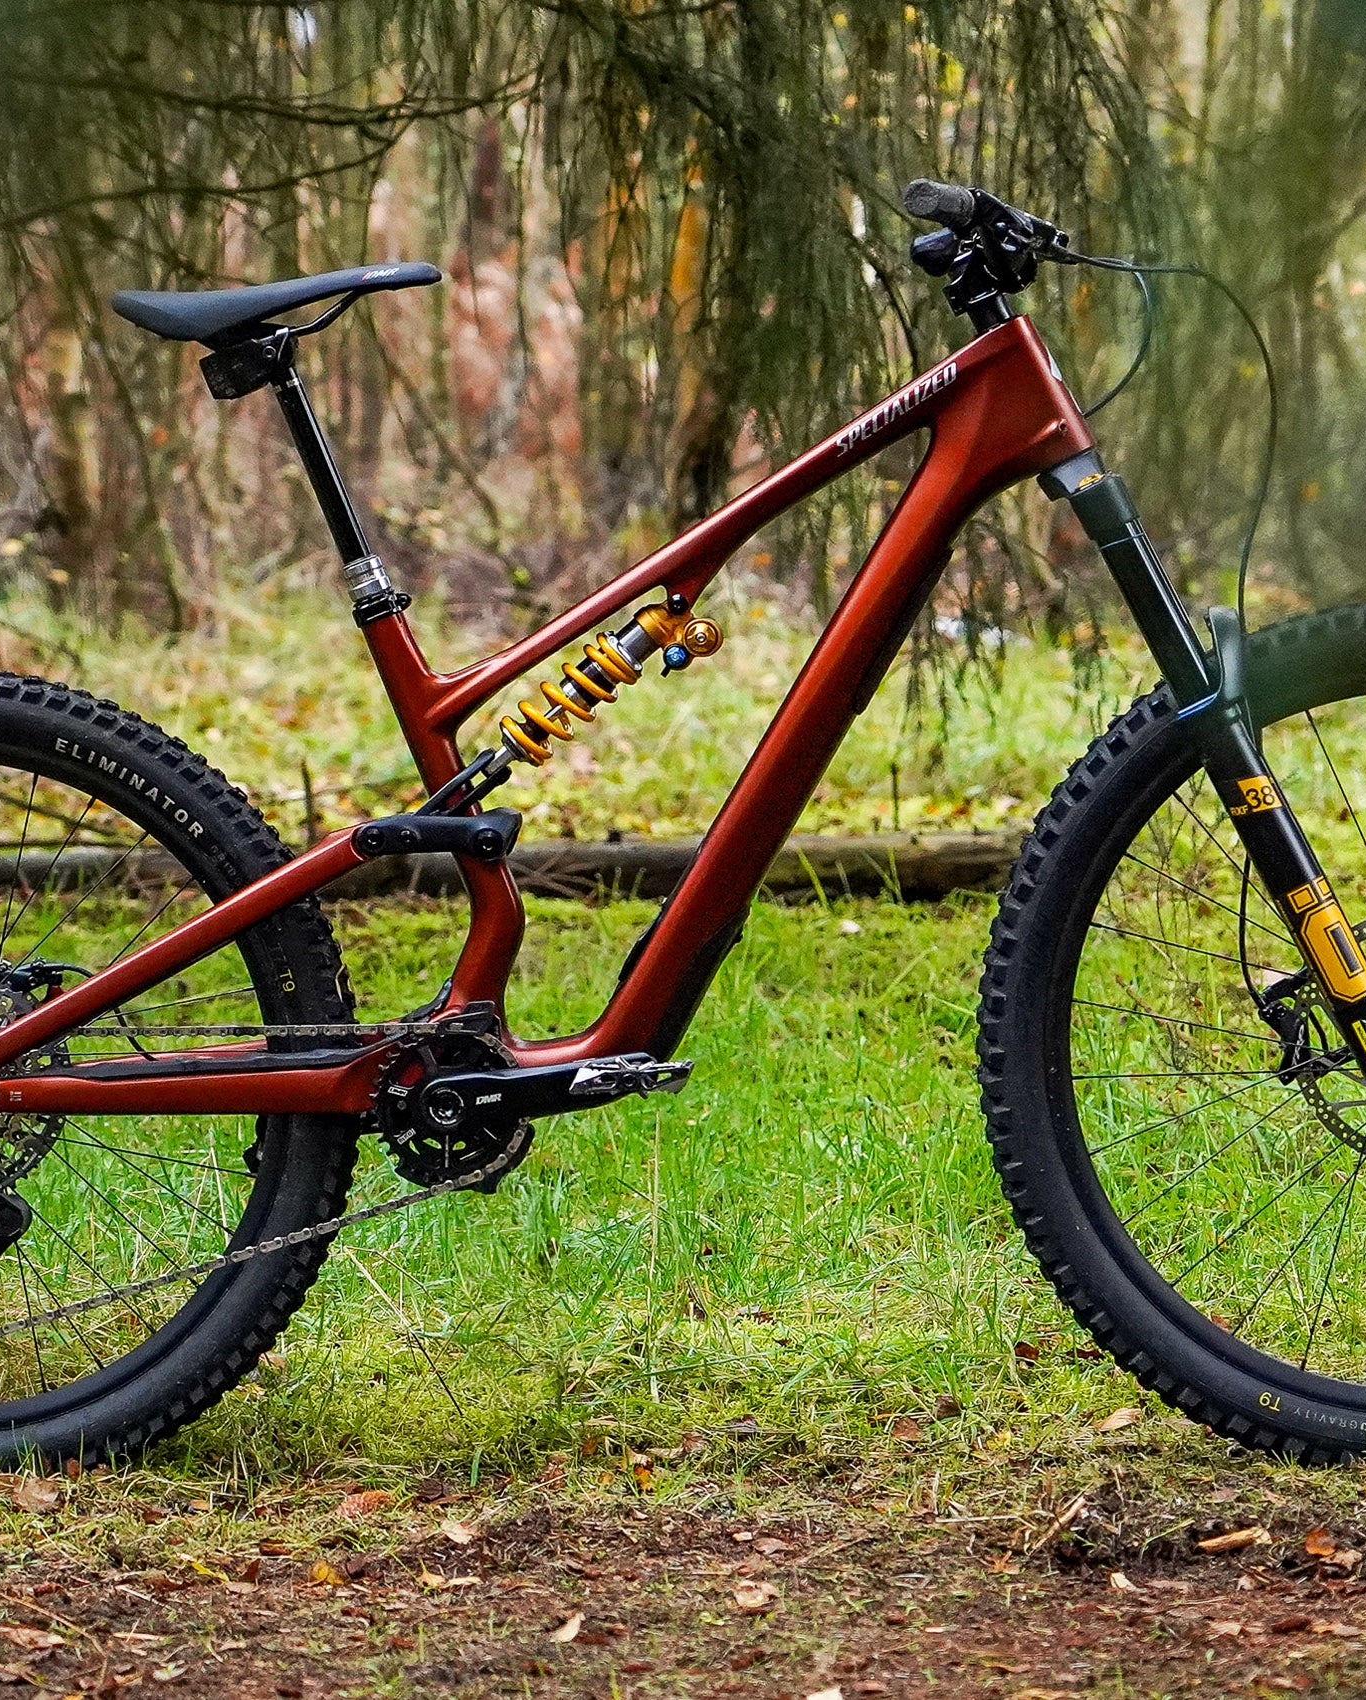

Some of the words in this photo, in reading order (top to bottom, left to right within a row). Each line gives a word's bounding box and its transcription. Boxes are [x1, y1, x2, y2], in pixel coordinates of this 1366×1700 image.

[836, 362, 957, 458] SPECIALIZED
[1245, 785, 1276, 809] 38
[55, 738, 204, 839] ELIMINATOR
[280, 968, 296, 993] T9
[475, 1092, 502, 1106] DMR
[1258, 1391, 1281, 1412] T9
